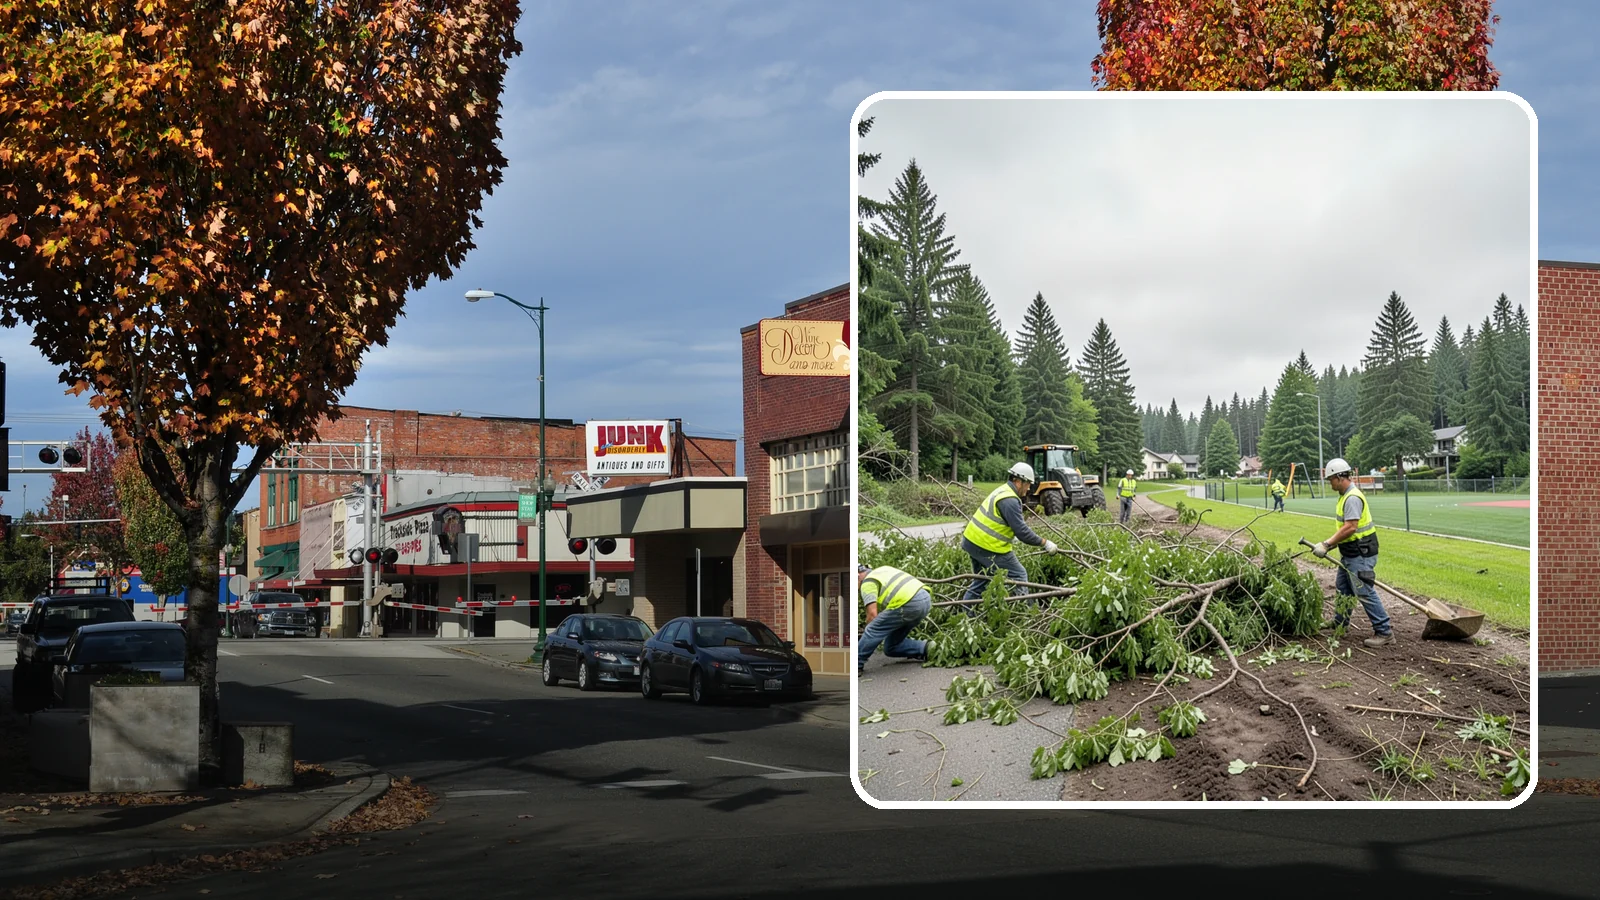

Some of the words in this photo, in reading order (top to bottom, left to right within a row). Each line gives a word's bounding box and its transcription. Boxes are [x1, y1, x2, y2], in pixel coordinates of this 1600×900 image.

[765, 328, 831, 365] Decor
[595, 425, 665, 457] JUNK
[607, 446, 645, 454] DISORDERLY
[597, 461, 628, 470] ANTIQUES
[631, 461, 643, 470] AND
[647, 460, 665, 469] GIFTS
[573, 473, 588, 491] RAIL
[390, 522, 413, 540] Trackside
[414, 520, 429, 535] Pizza
